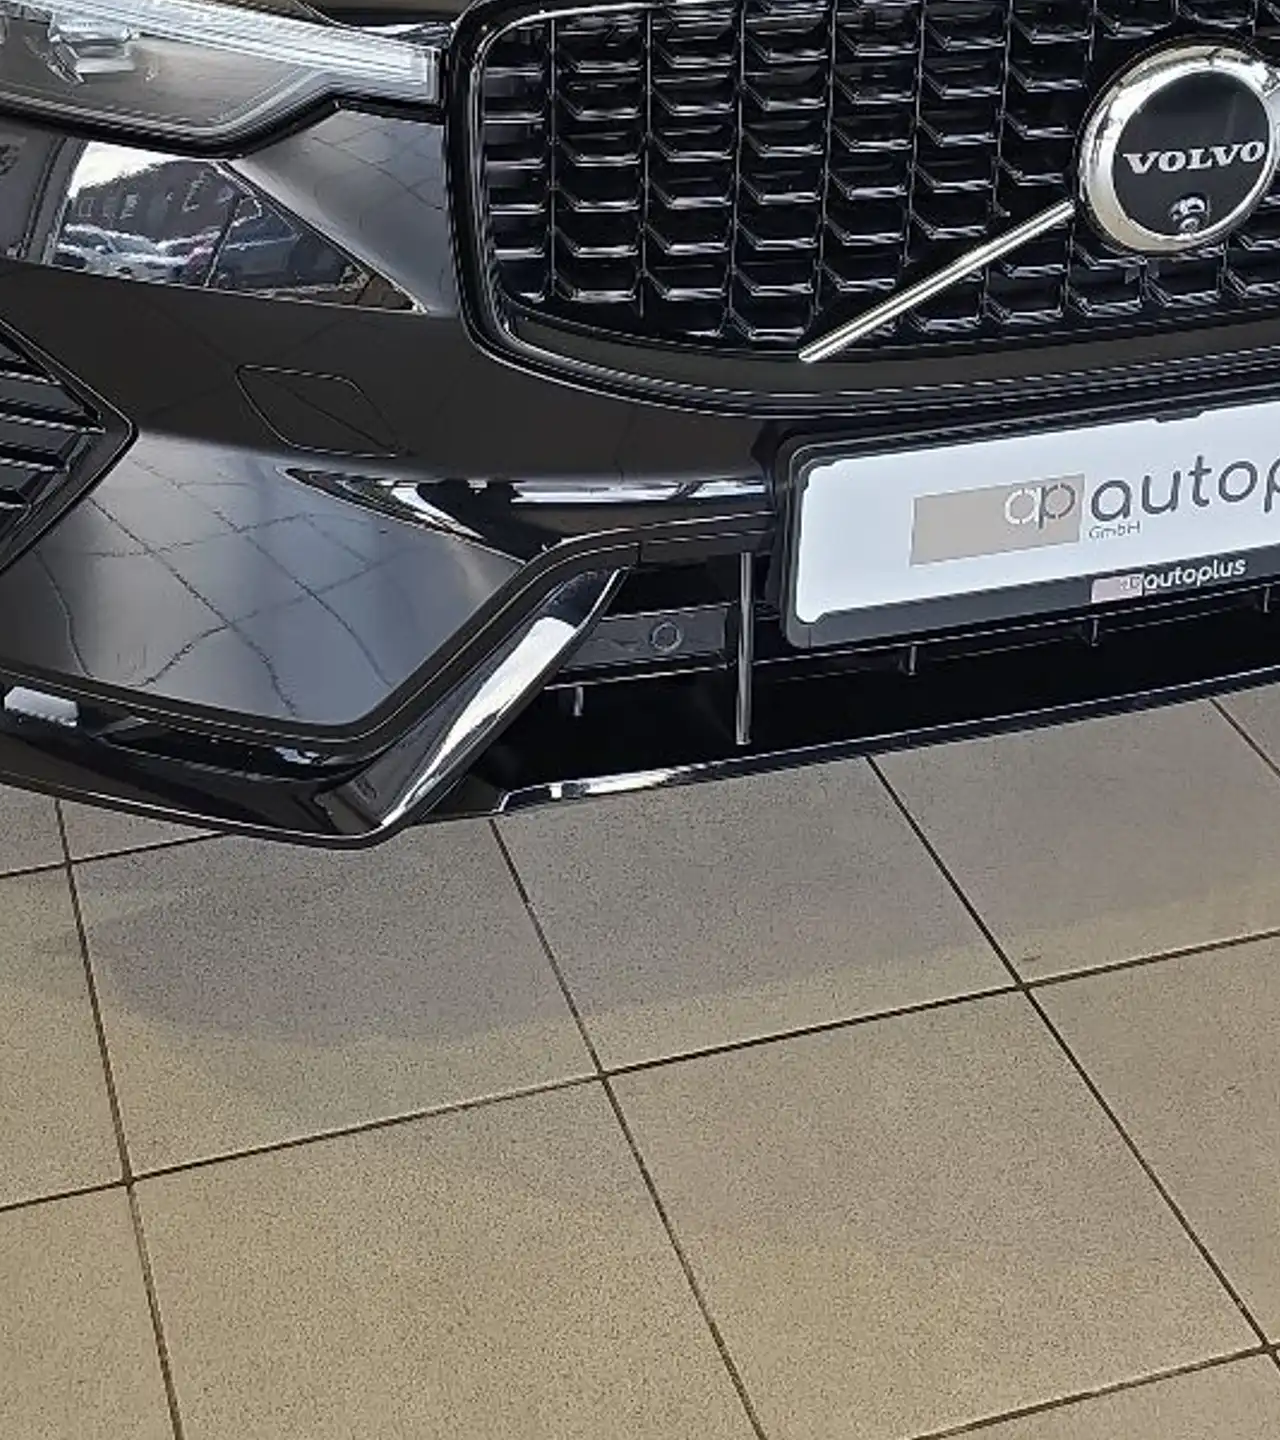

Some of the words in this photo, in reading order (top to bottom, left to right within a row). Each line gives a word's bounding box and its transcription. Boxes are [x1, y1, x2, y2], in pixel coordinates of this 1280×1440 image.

[1122, 140, 1266, 175] VOLVO
[1088, 520, 1142, 540] GmbH
[1143, 558, 1247, 588] autoplus
